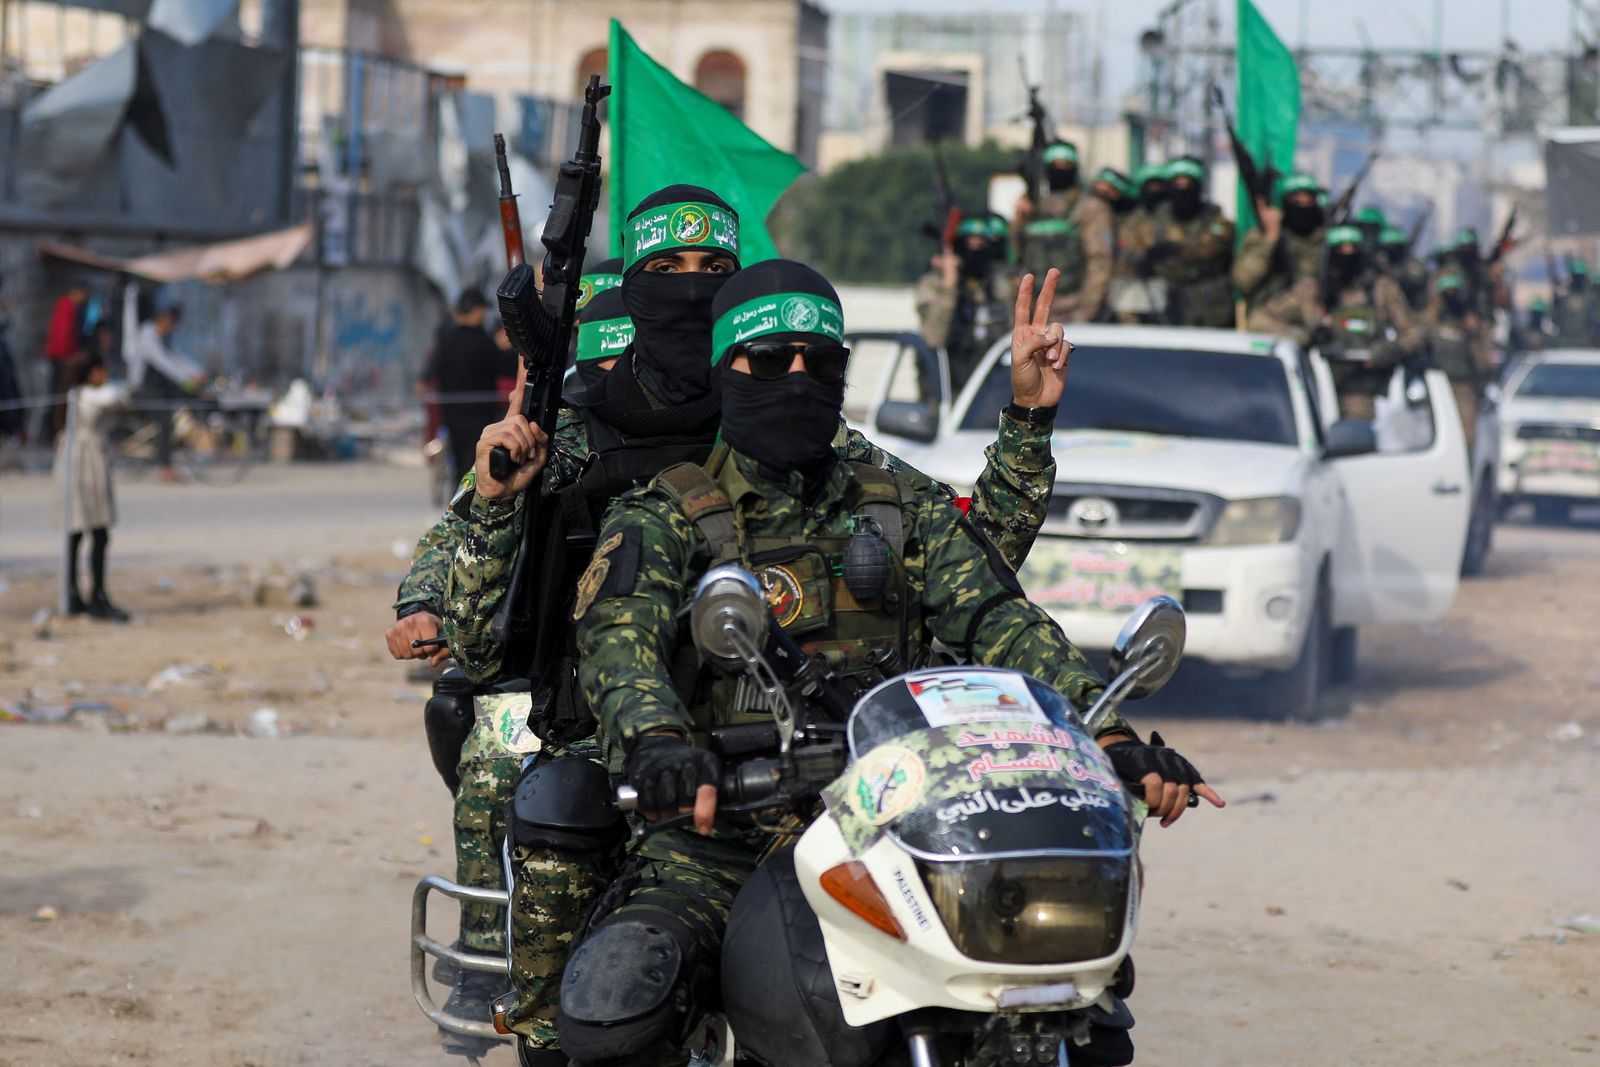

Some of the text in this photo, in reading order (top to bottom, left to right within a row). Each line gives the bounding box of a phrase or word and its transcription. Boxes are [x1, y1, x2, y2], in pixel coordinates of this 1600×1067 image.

[641, 218, 653, 230] رسول
[653, 214, 668, 222] محمد
[636, 225, 667, 256] القسام
[741, 310, 757, 323] رسول
[757, 303, 777, 314] محمد
[600, 332, 632, 353] القسام
[734, 316, 778, 343] القسام
[956, 724, 1075, 751] الشهيد
[966, 751, 1064, 782] القسام
[935, 790, 1000, 824] النبي
[1000, 786, 1059, 813] على
[893, 870, 929, 929] PALESTINE
